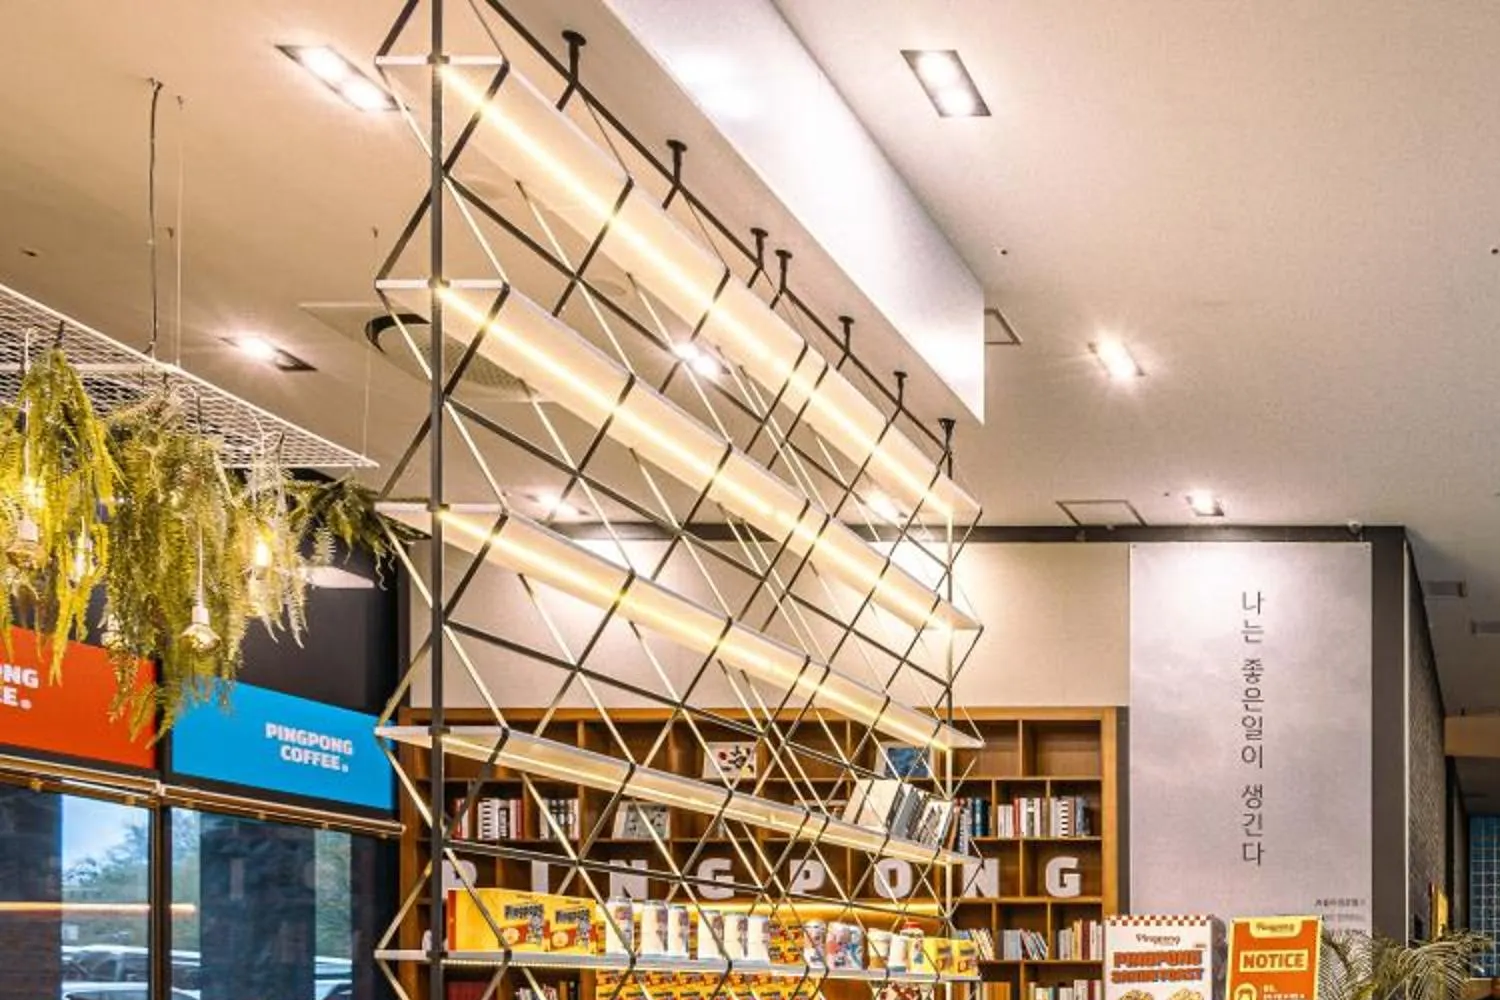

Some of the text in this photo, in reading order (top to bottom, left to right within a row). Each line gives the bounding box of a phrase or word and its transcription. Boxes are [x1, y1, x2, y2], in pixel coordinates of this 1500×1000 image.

[1242, 591, 1265, 643] 나는
[0, 664, 39, 689] NG
[265, 722, 353, 756] PINGPONG
[1241, 784, 1265, 866] 생긴다
[1243, 953, 1305, 969] NOTICE
